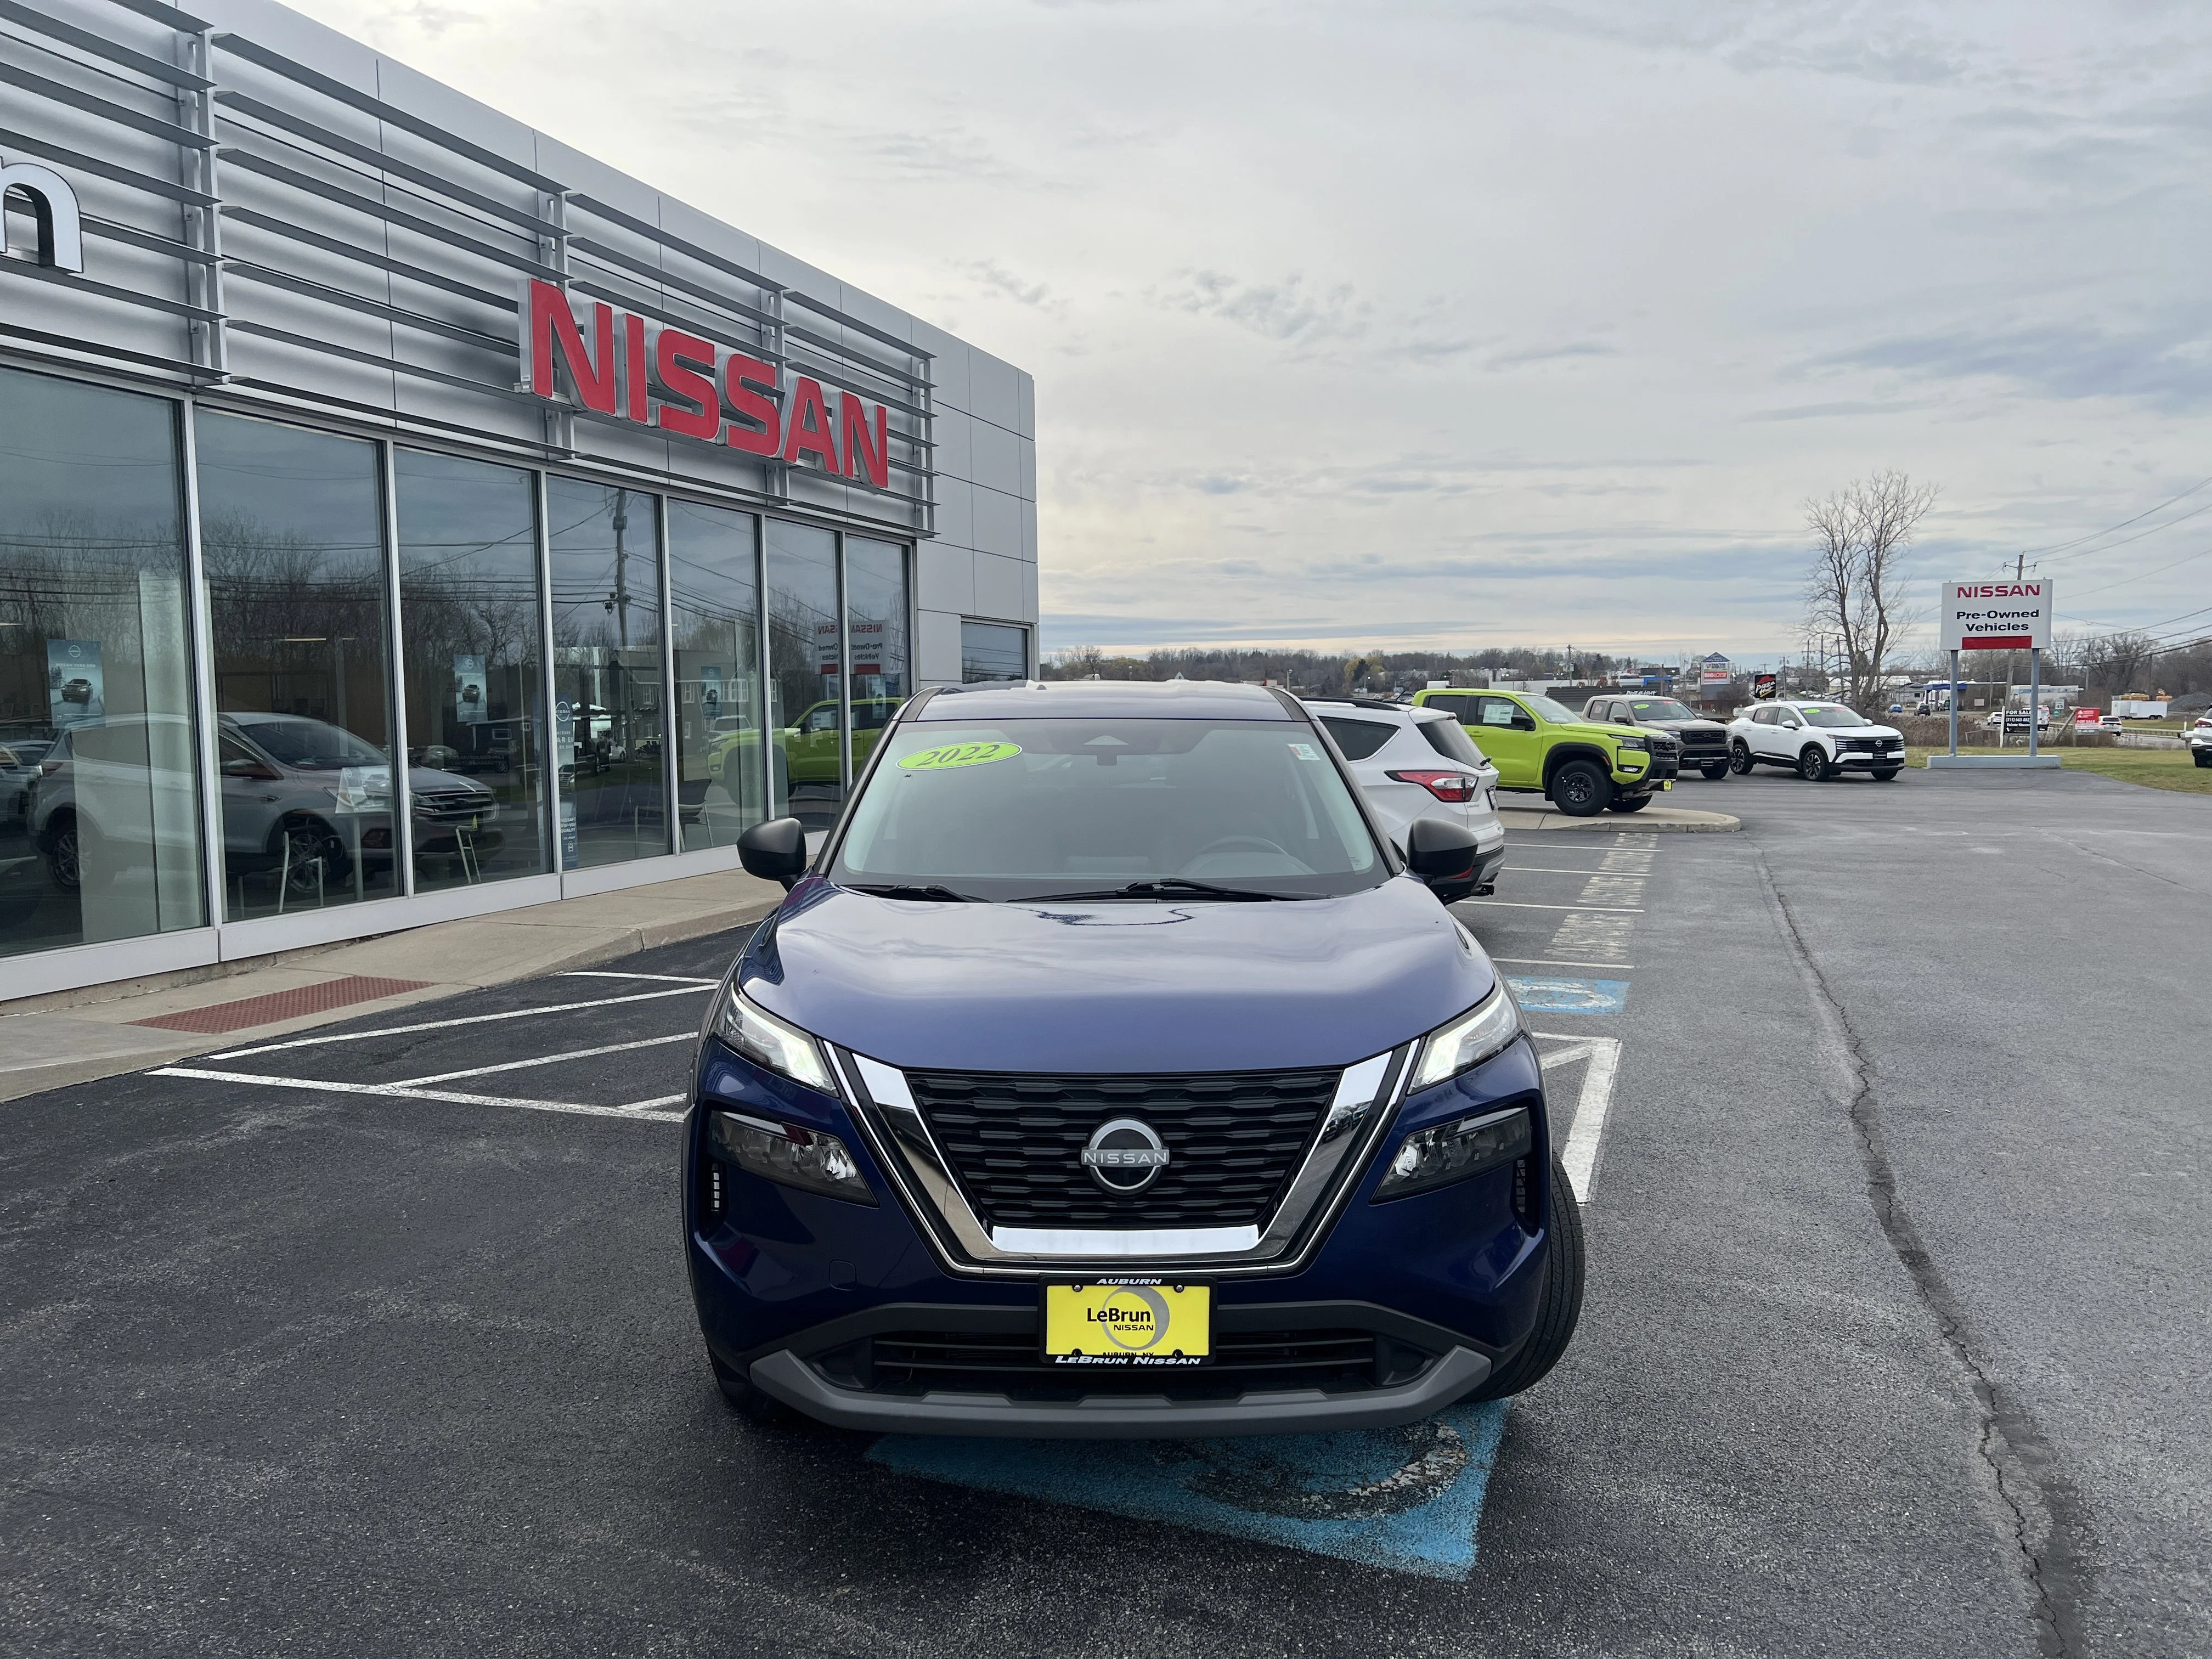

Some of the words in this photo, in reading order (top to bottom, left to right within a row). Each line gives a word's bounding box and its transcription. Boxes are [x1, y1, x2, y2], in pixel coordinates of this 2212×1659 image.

[520, 278, 888, 489] NISSAN
[1957, 584, 2040, 598] NISSAN
[1956, 609, 2039, 619] Pre-Owned
[1966, 623, 2029, 631] Vehicles
[1756, 681, 1775, 693] Pizza
[1759, 686, 1774, 695] Hut
[916, 744, 1001, 766] 2022
[1084, 1152, 1167, 1164] NISSAN
[1087, 1308, 1150, 1322] LeBrun
[1133, 1357, 1201, 1365] NISSAN
